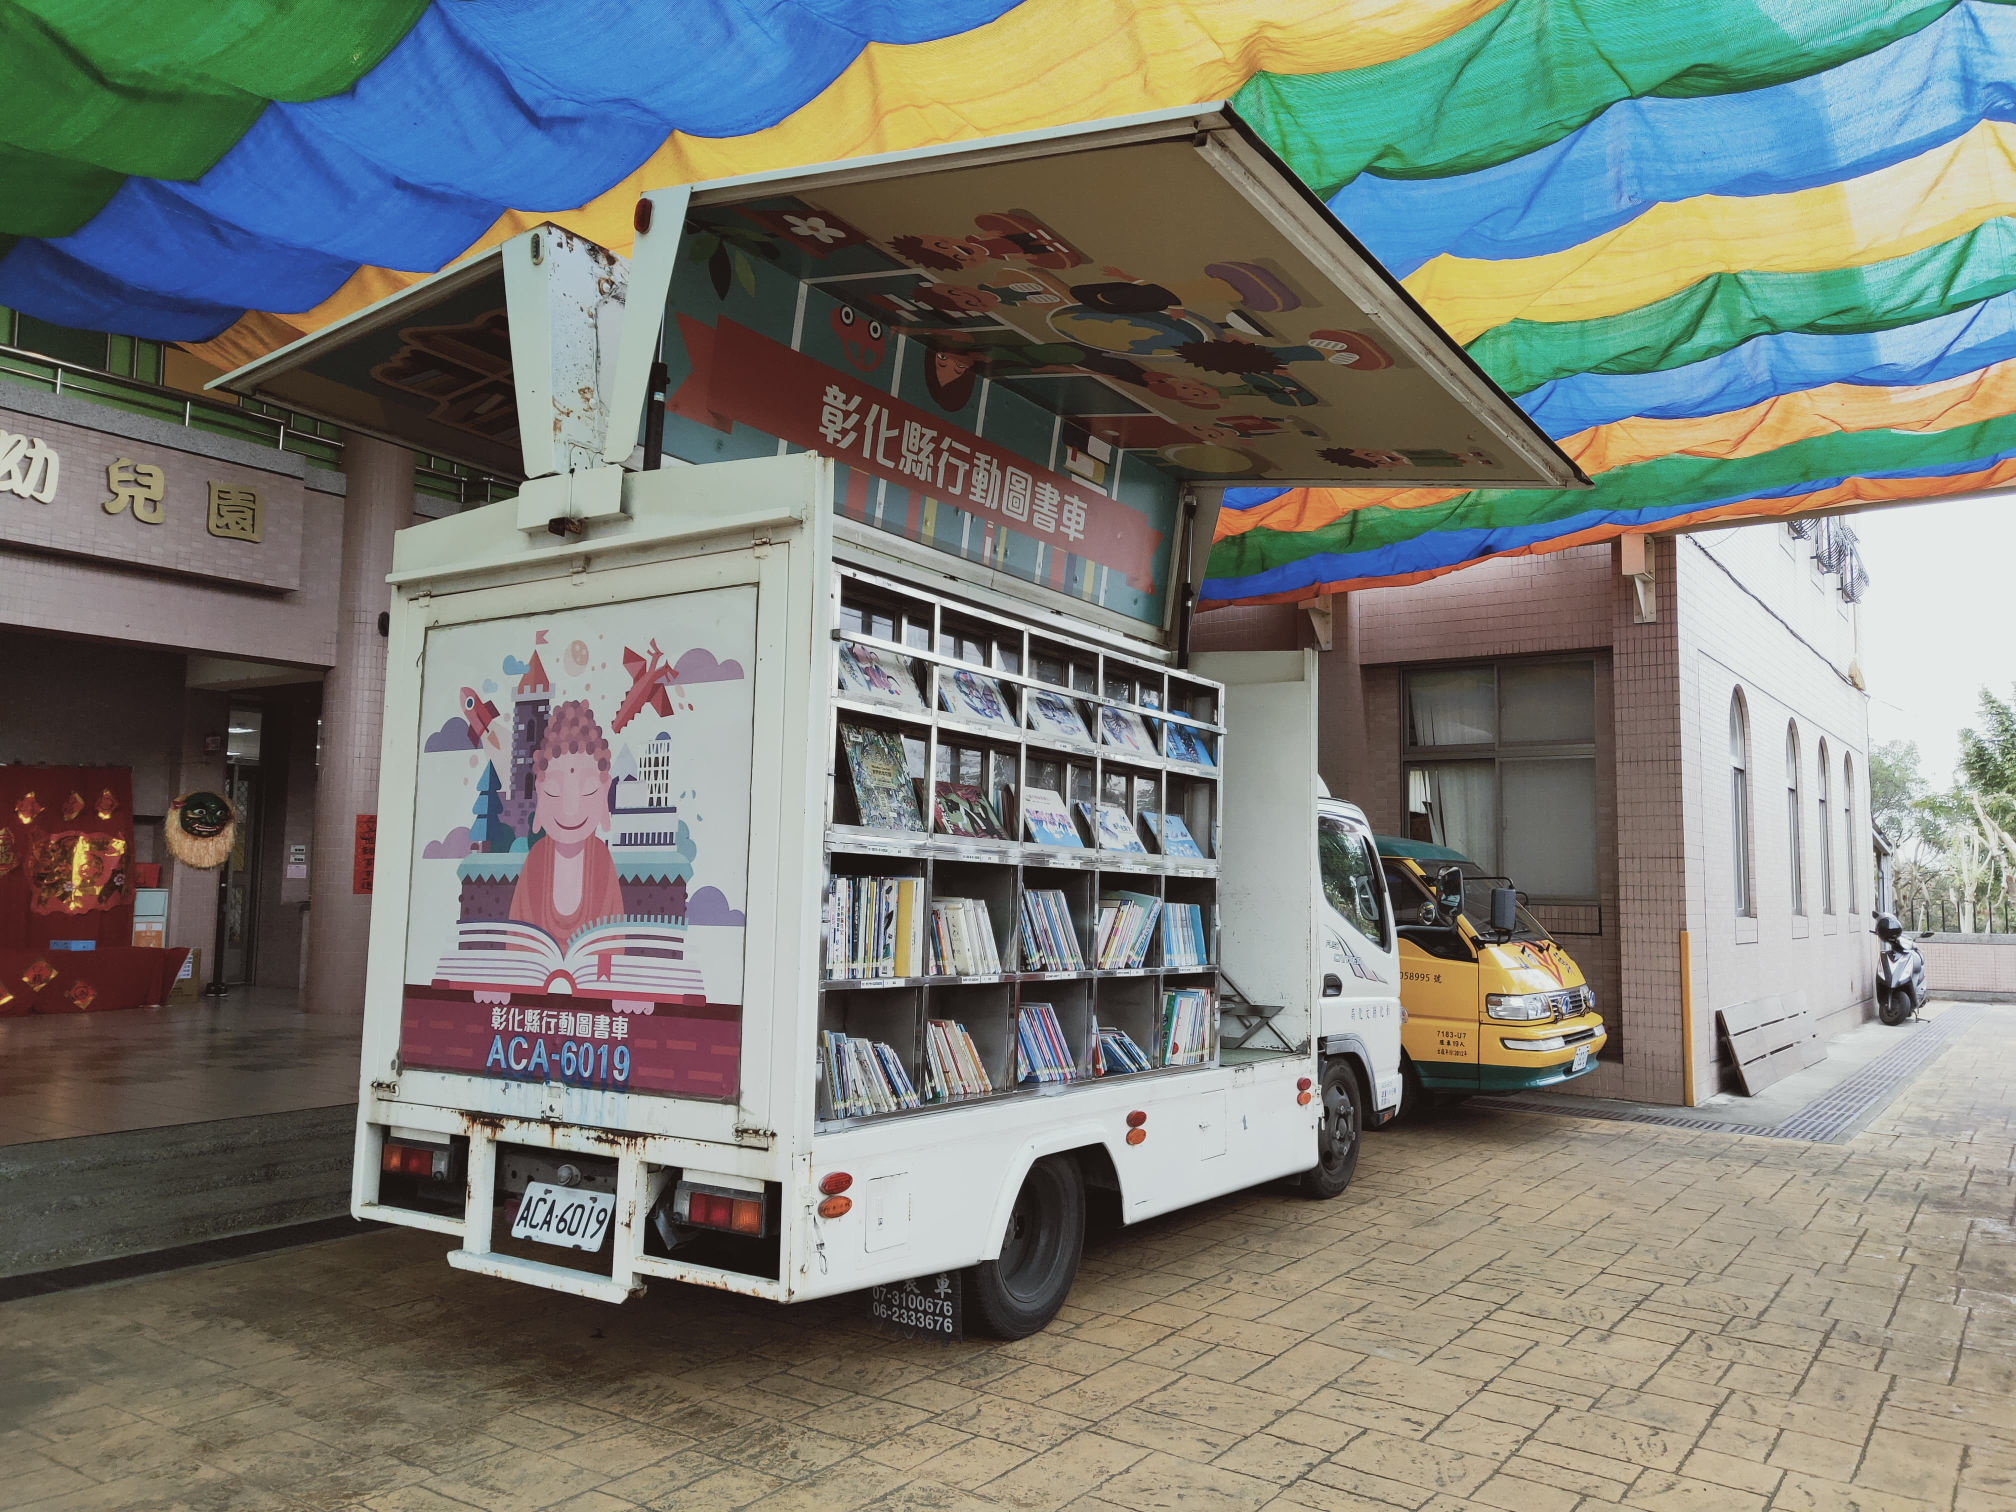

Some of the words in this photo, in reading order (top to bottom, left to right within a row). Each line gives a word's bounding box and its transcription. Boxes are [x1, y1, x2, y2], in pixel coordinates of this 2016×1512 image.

[818, 384, 1089, 542] 彰化縣行動圖書車
[491, 1006, 629, 1041] 彰化縣行動圖書車
[1437, 1030, 1467, 1039] 7183-U7
[486, 1034, 631, 1082] ACA-6019
[873, 1286, 953, 1316] 07-3100676
[873, 1302, 953, 1333] 06-2333676
